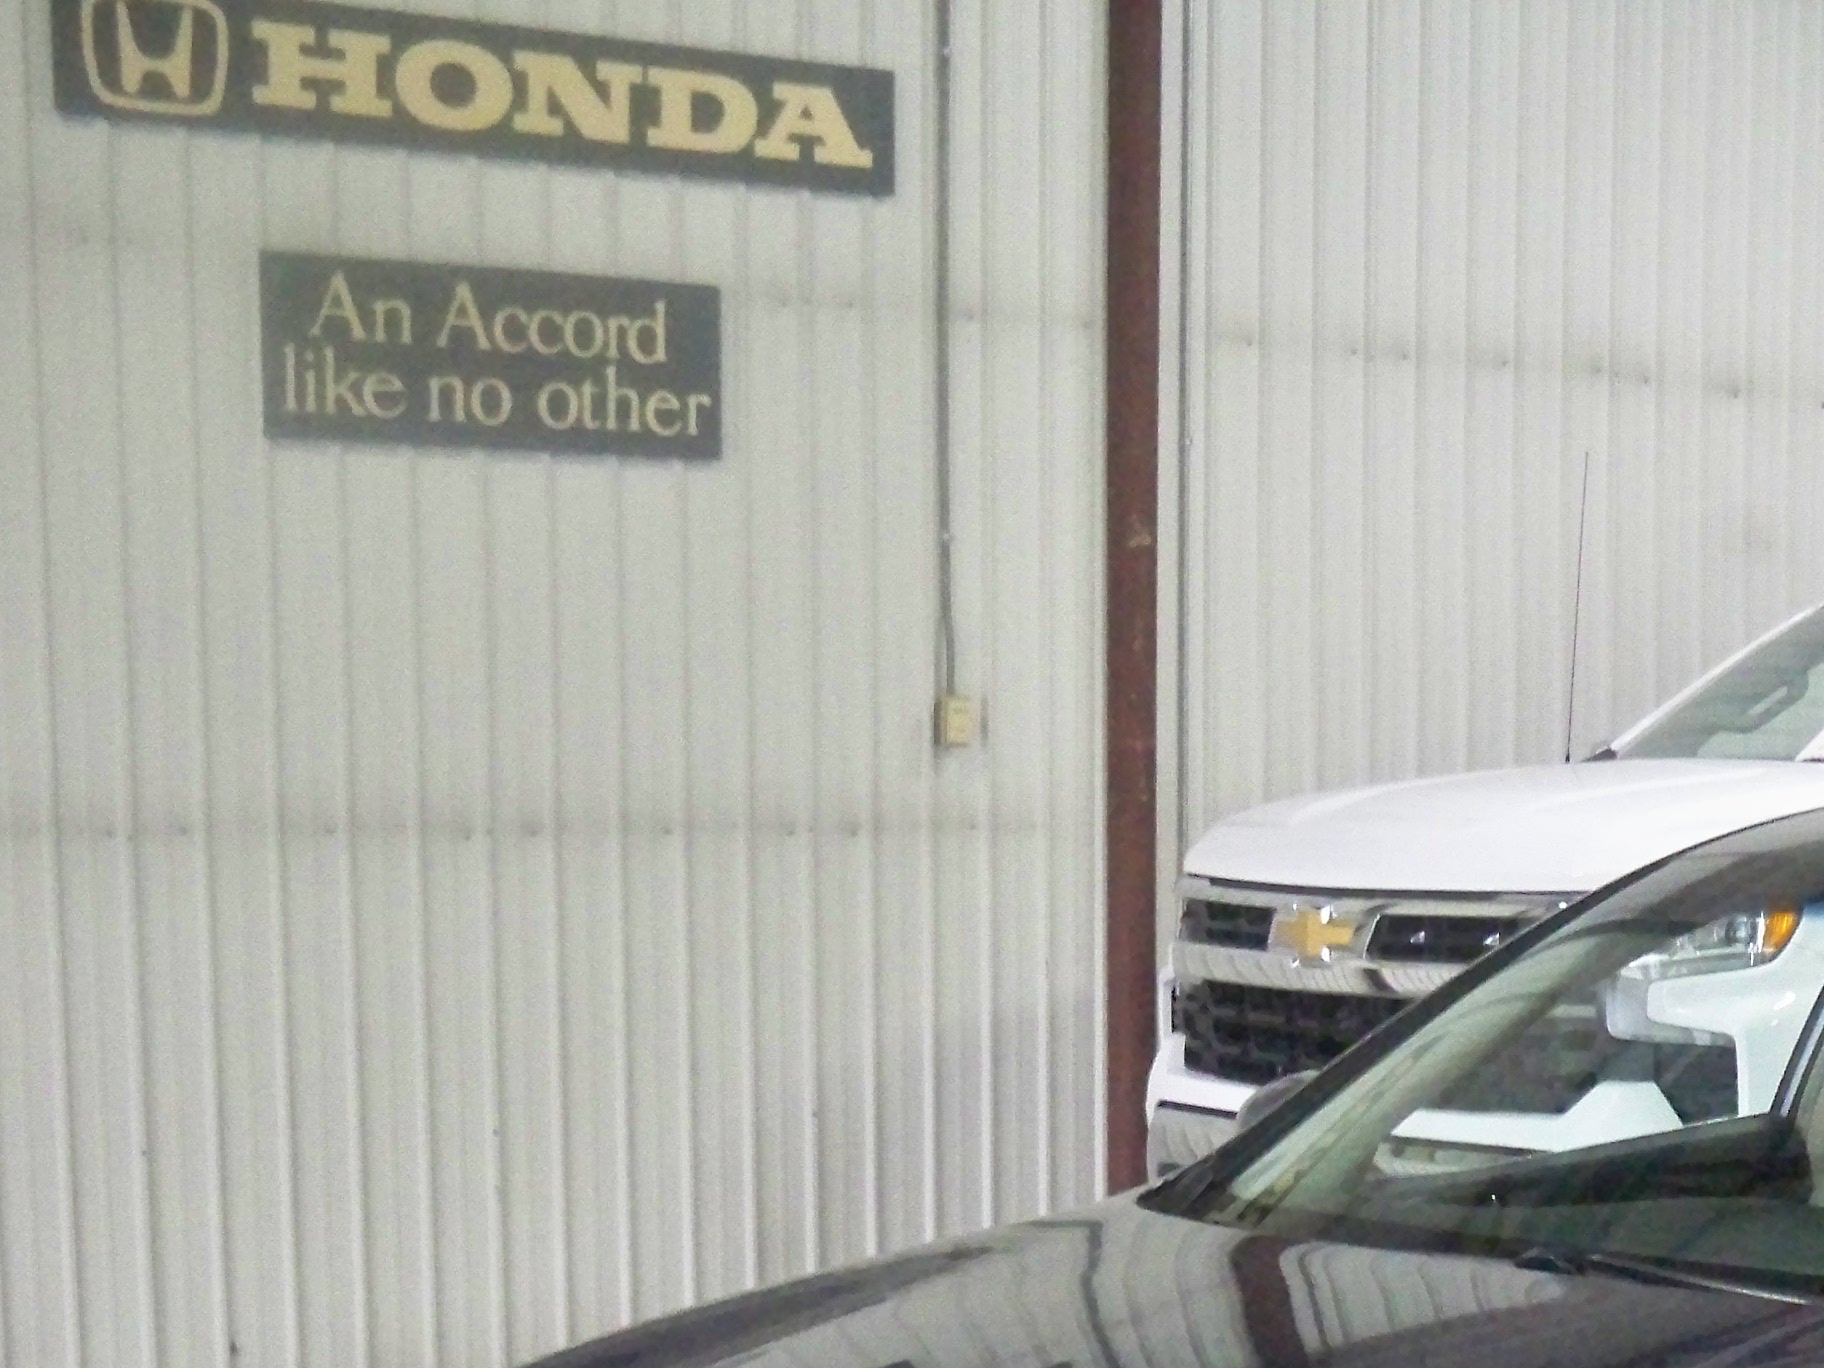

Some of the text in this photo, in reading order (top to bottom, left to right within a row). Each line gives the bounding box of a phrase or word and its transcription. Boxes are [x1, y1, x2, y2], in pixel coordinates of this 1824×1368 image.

[250, 19, 873, 169] HONDA
[309, 271, 667, 365] An Accord
[282, 344, 713, 438] like no other
